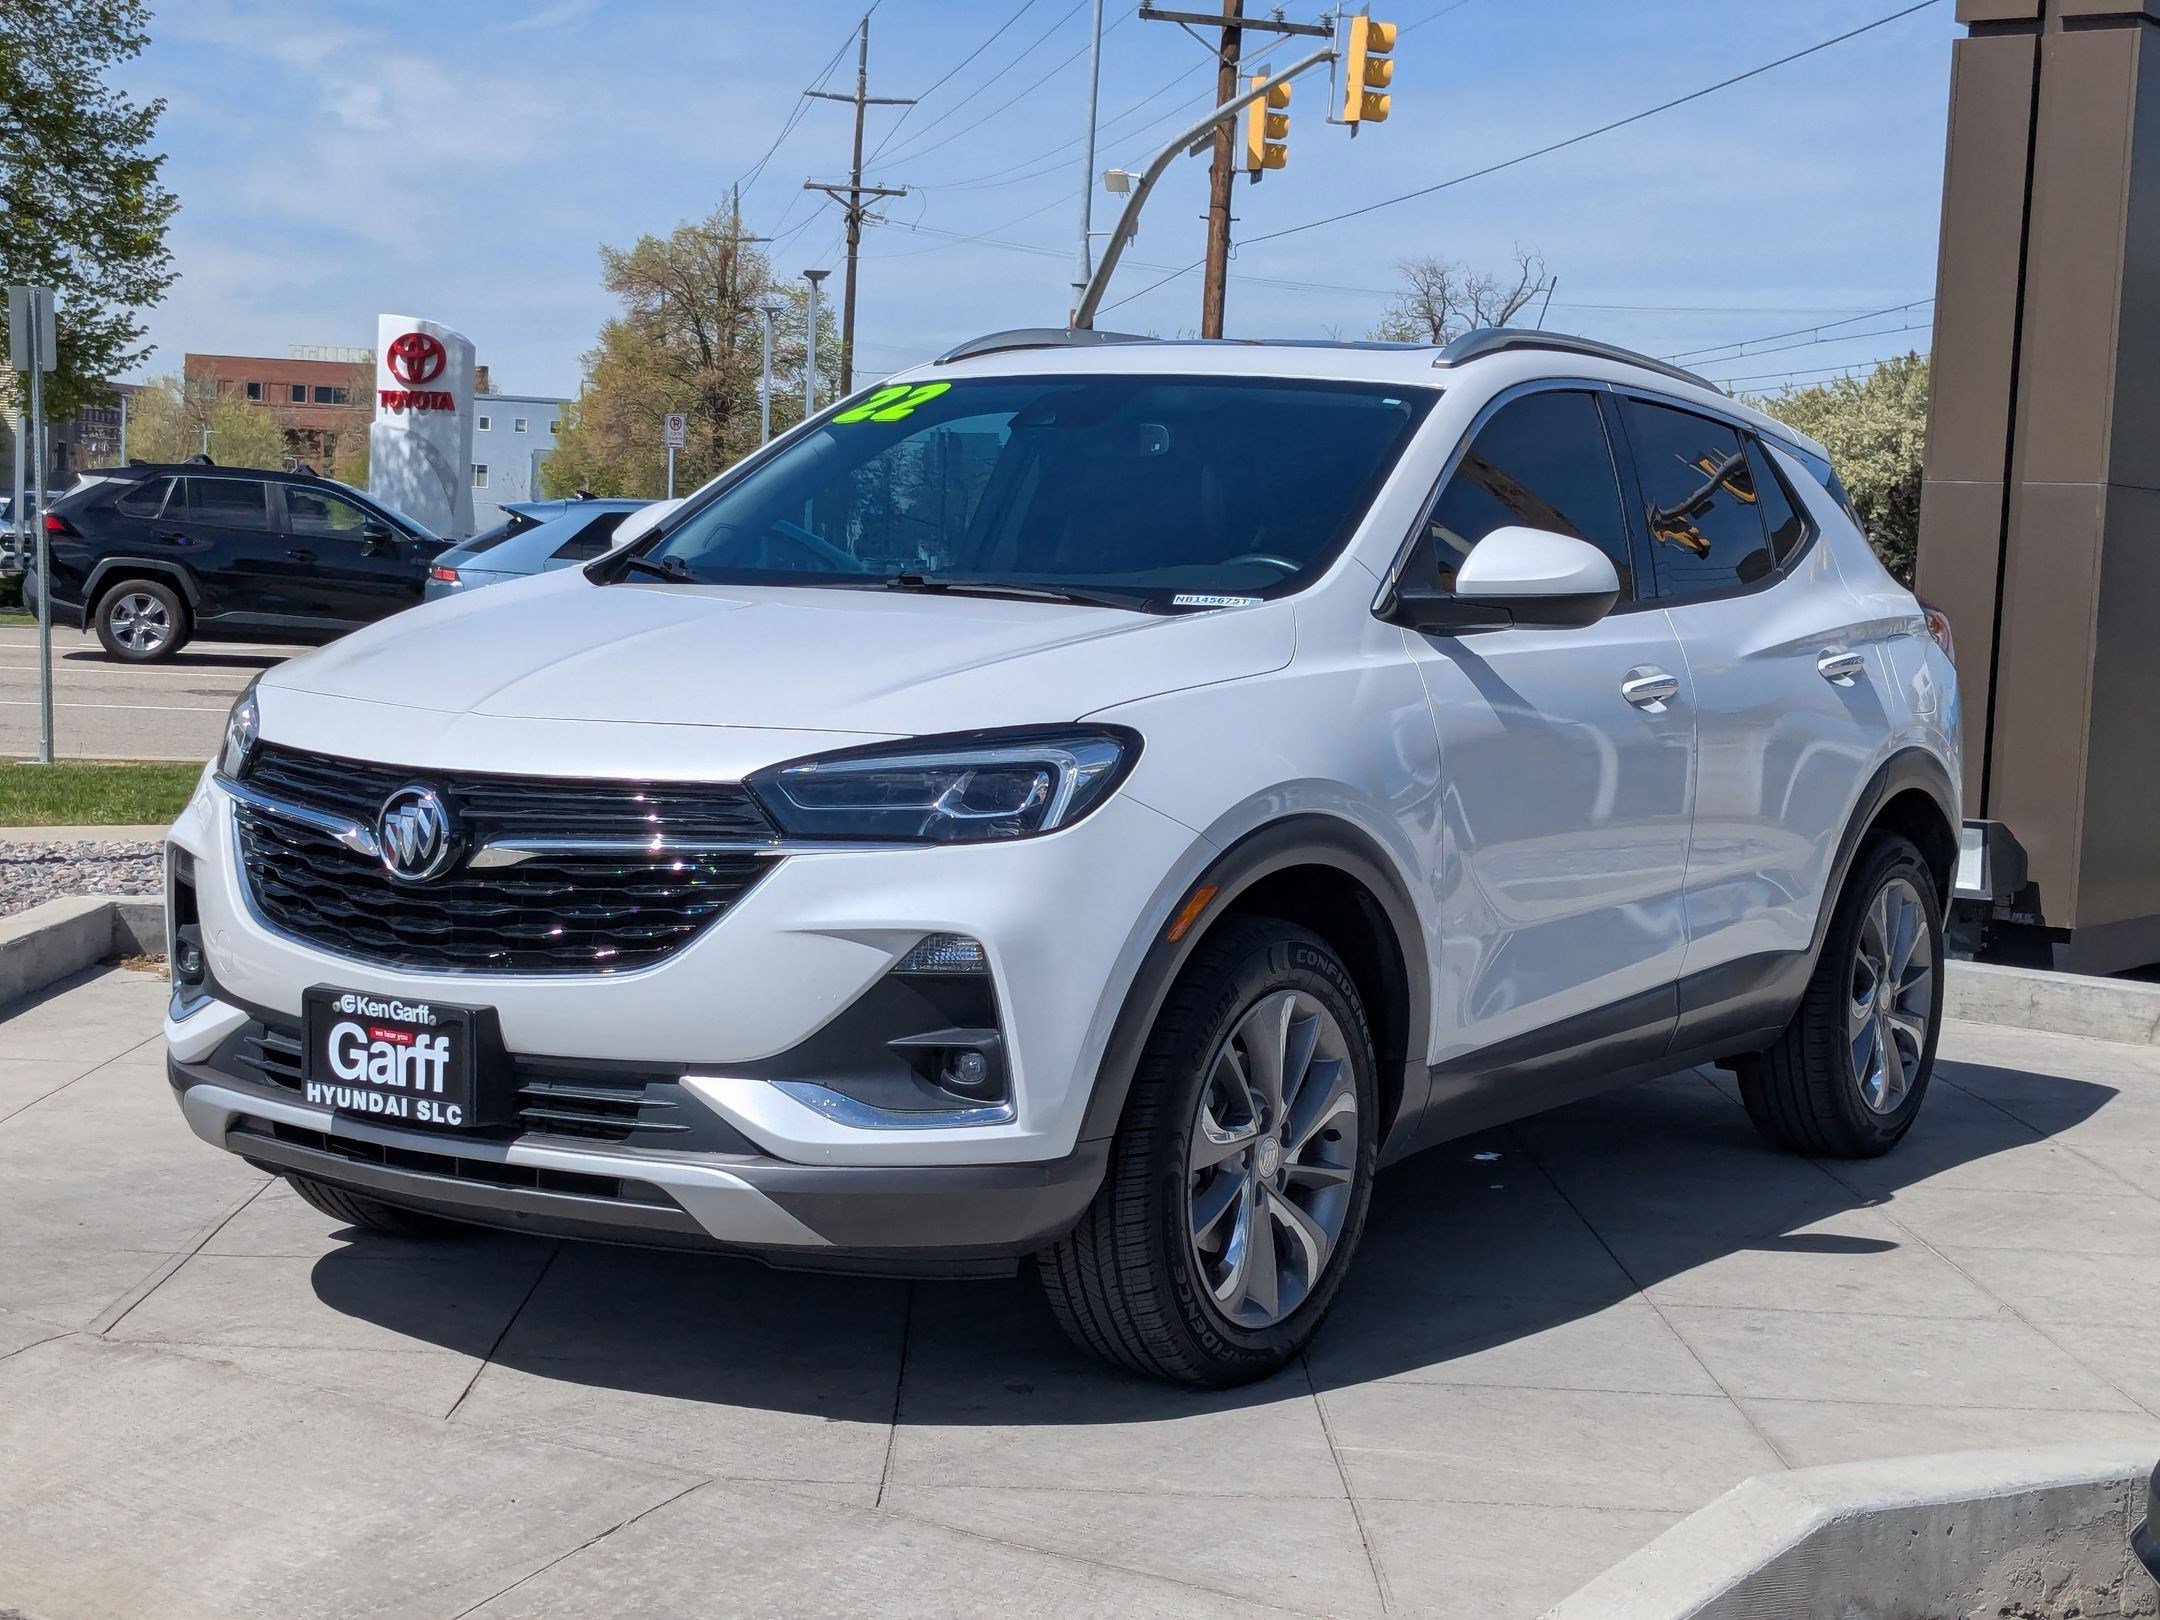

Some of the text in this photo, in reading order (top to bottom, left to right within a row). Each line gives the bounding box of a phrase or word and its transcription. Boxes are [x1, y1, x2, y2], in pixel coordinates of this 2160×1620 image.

[378, 390, 456, 411] TOYOTA
[831, 383, 952, 423] 22
[328, 1022, 449, 1093] Garff
[306, 1082, 462, 1126] HYUNDAI SLC
